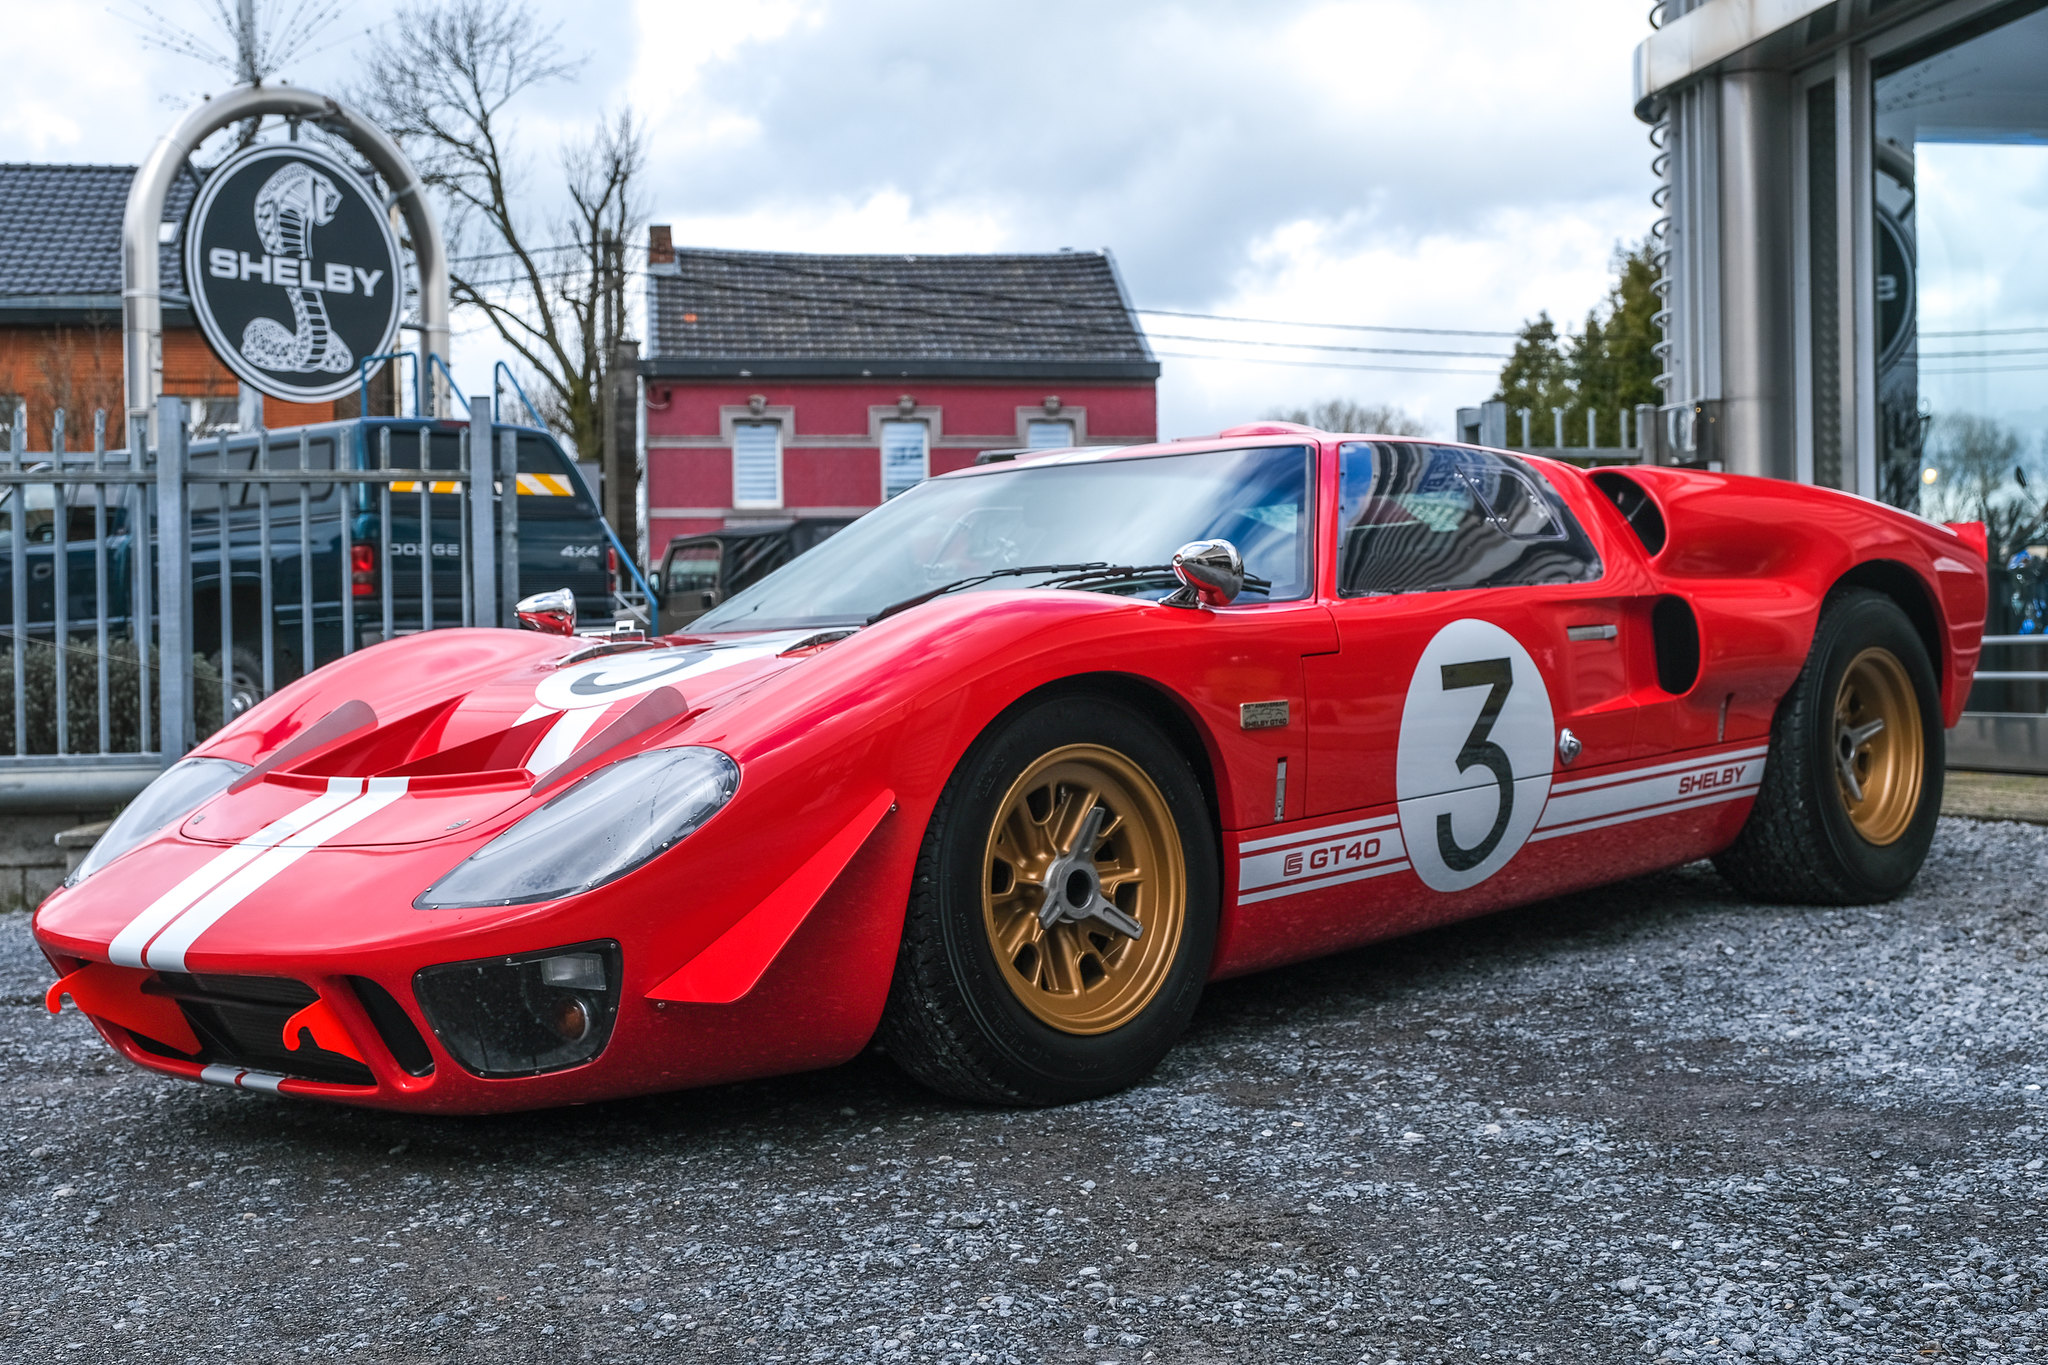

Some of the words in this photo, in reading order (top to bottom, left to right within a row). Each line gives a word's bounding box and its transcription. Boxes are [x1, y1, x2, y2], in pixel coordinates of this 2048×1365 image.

[209, 247, 385, 298] SHELBY
[1244, 720, 1269, 728] SHELBY
[1270, 718, 1287, 726] GT40
[1436, 656, 1515, 872] 3
[1678, 765, 1747, 795] SHELBY
[1309, 838, 1381, 869] GT40
